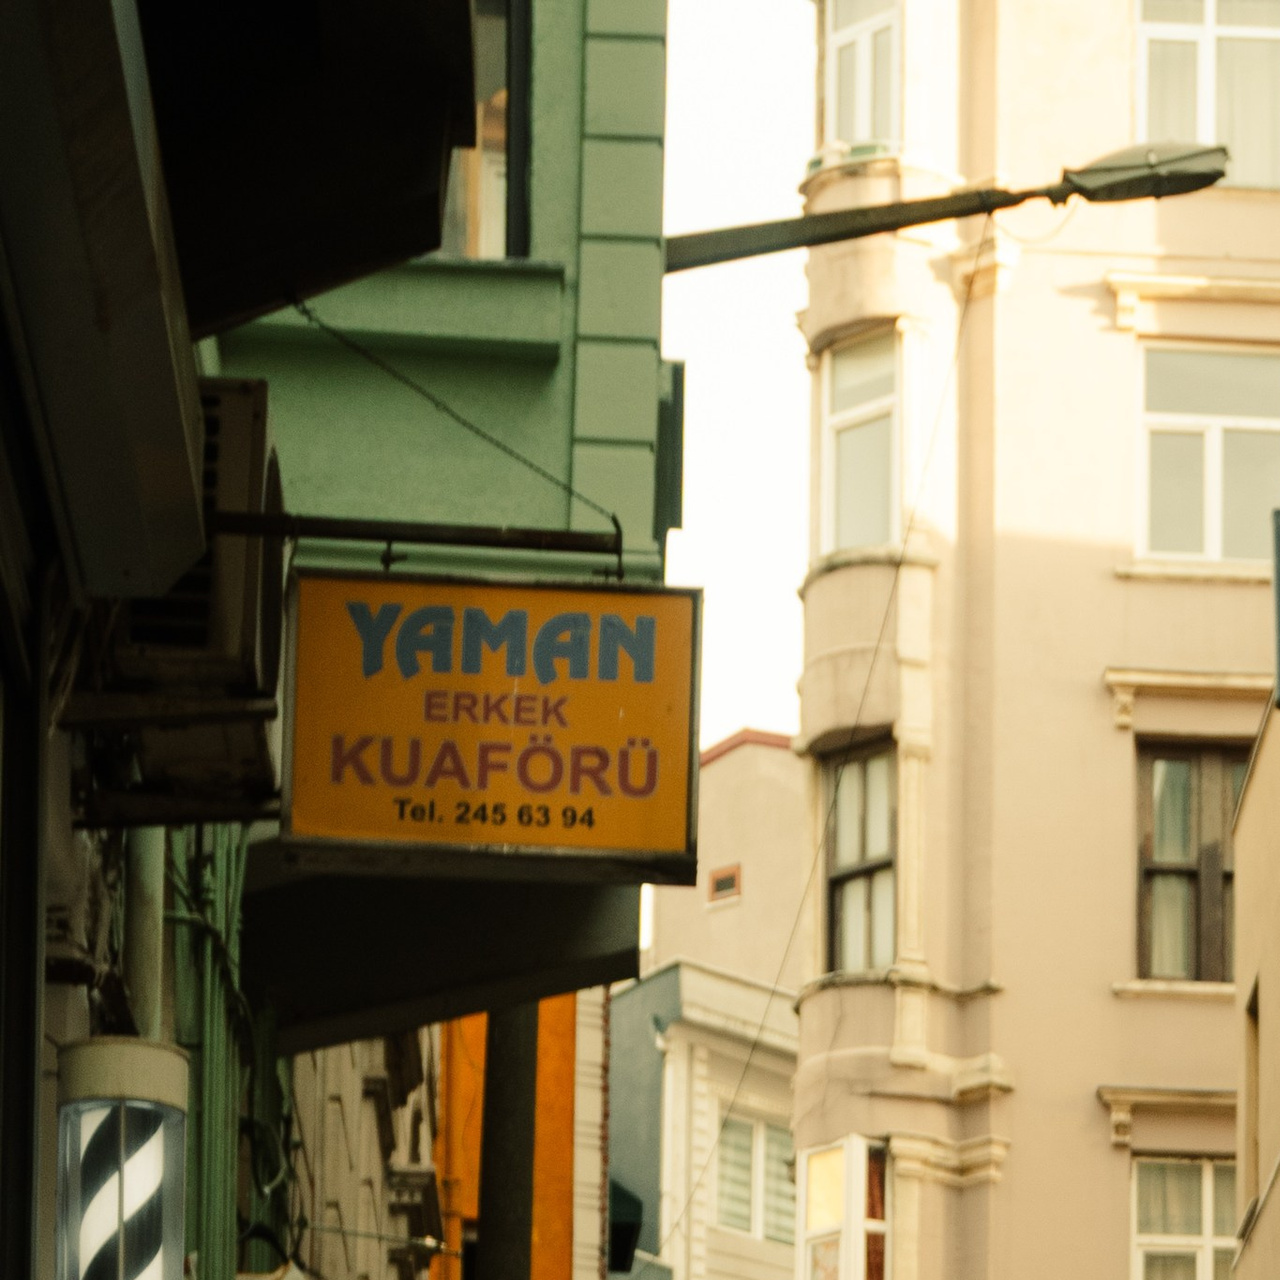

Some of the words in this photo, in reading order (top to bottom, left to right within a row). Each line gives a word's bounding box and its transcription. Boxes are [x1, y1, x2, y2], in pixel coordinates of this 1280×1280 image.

[346, 601, 656, 686] YAMAN
[423, 690, 569, 728] ERKEK
[330, 733, 659, 798] KUAFÖRÜ
[395, 799, 443, 823] Tel.
[455, 801, 507, 825] 245
[517, 804, 550, 827] 63
[561, 806, 595, 830] 94
